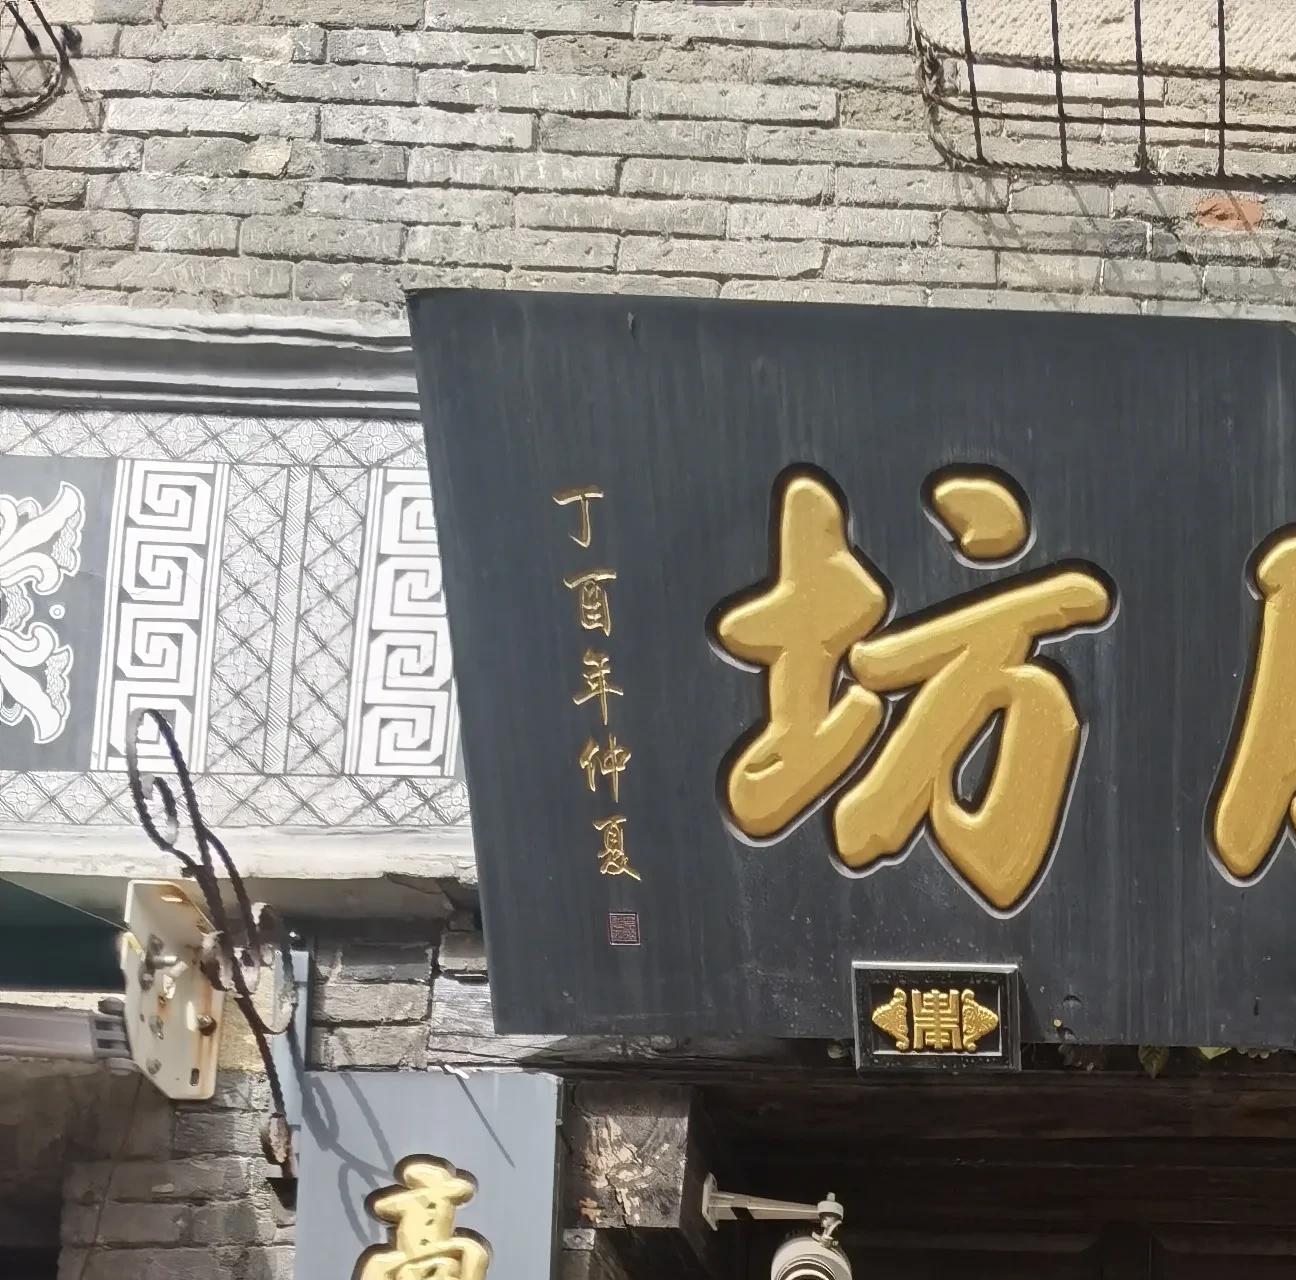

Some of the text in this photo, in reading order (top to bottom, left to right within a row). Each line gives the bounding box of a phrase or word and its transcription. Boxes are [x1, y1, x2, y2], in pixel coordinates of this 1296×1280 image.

[552, 485, 642, 882] 丁酉年仲夏
